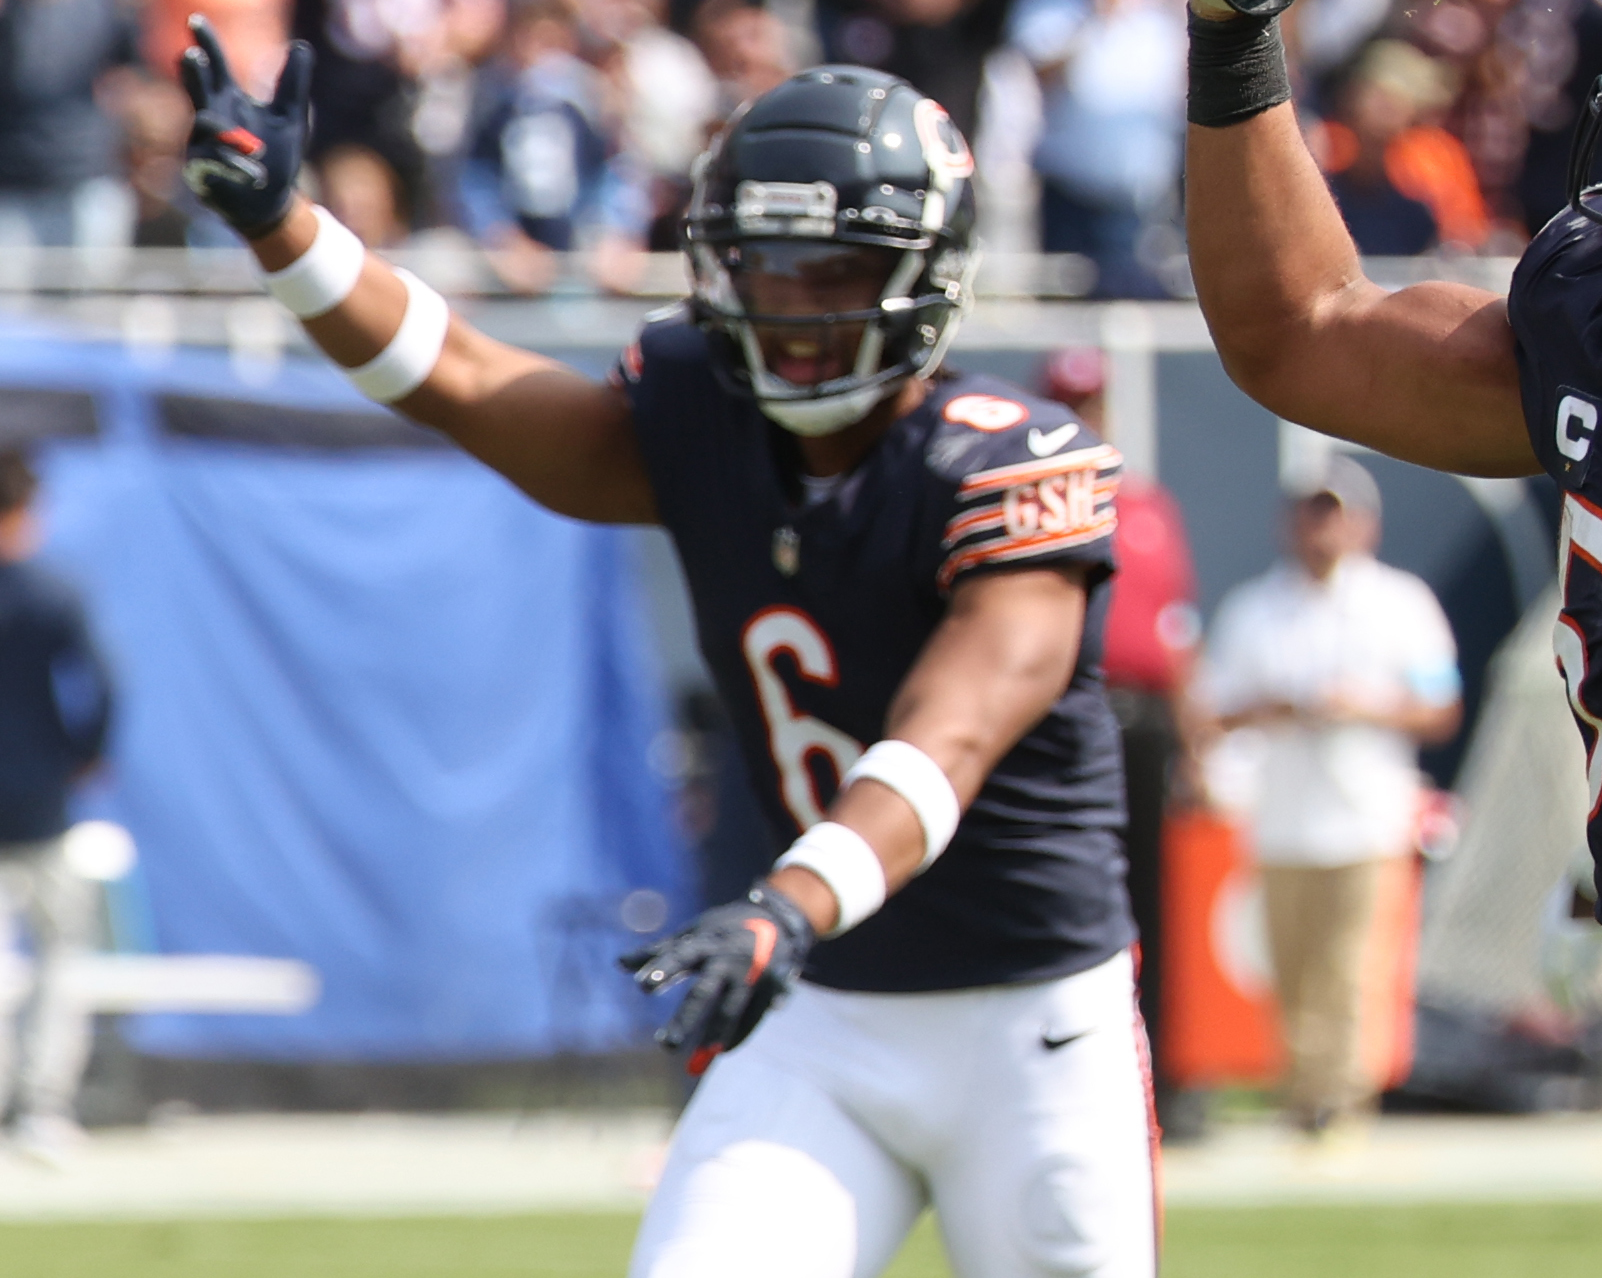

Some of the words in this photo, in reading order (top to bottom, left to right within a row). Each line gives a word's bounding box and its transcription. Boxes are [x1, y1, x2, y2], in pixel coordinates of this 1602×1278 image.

[1555, 394, 1598, 462] C
[1003, 470, 1096, 540] GSH
[739, 602, 868, 836] 6
